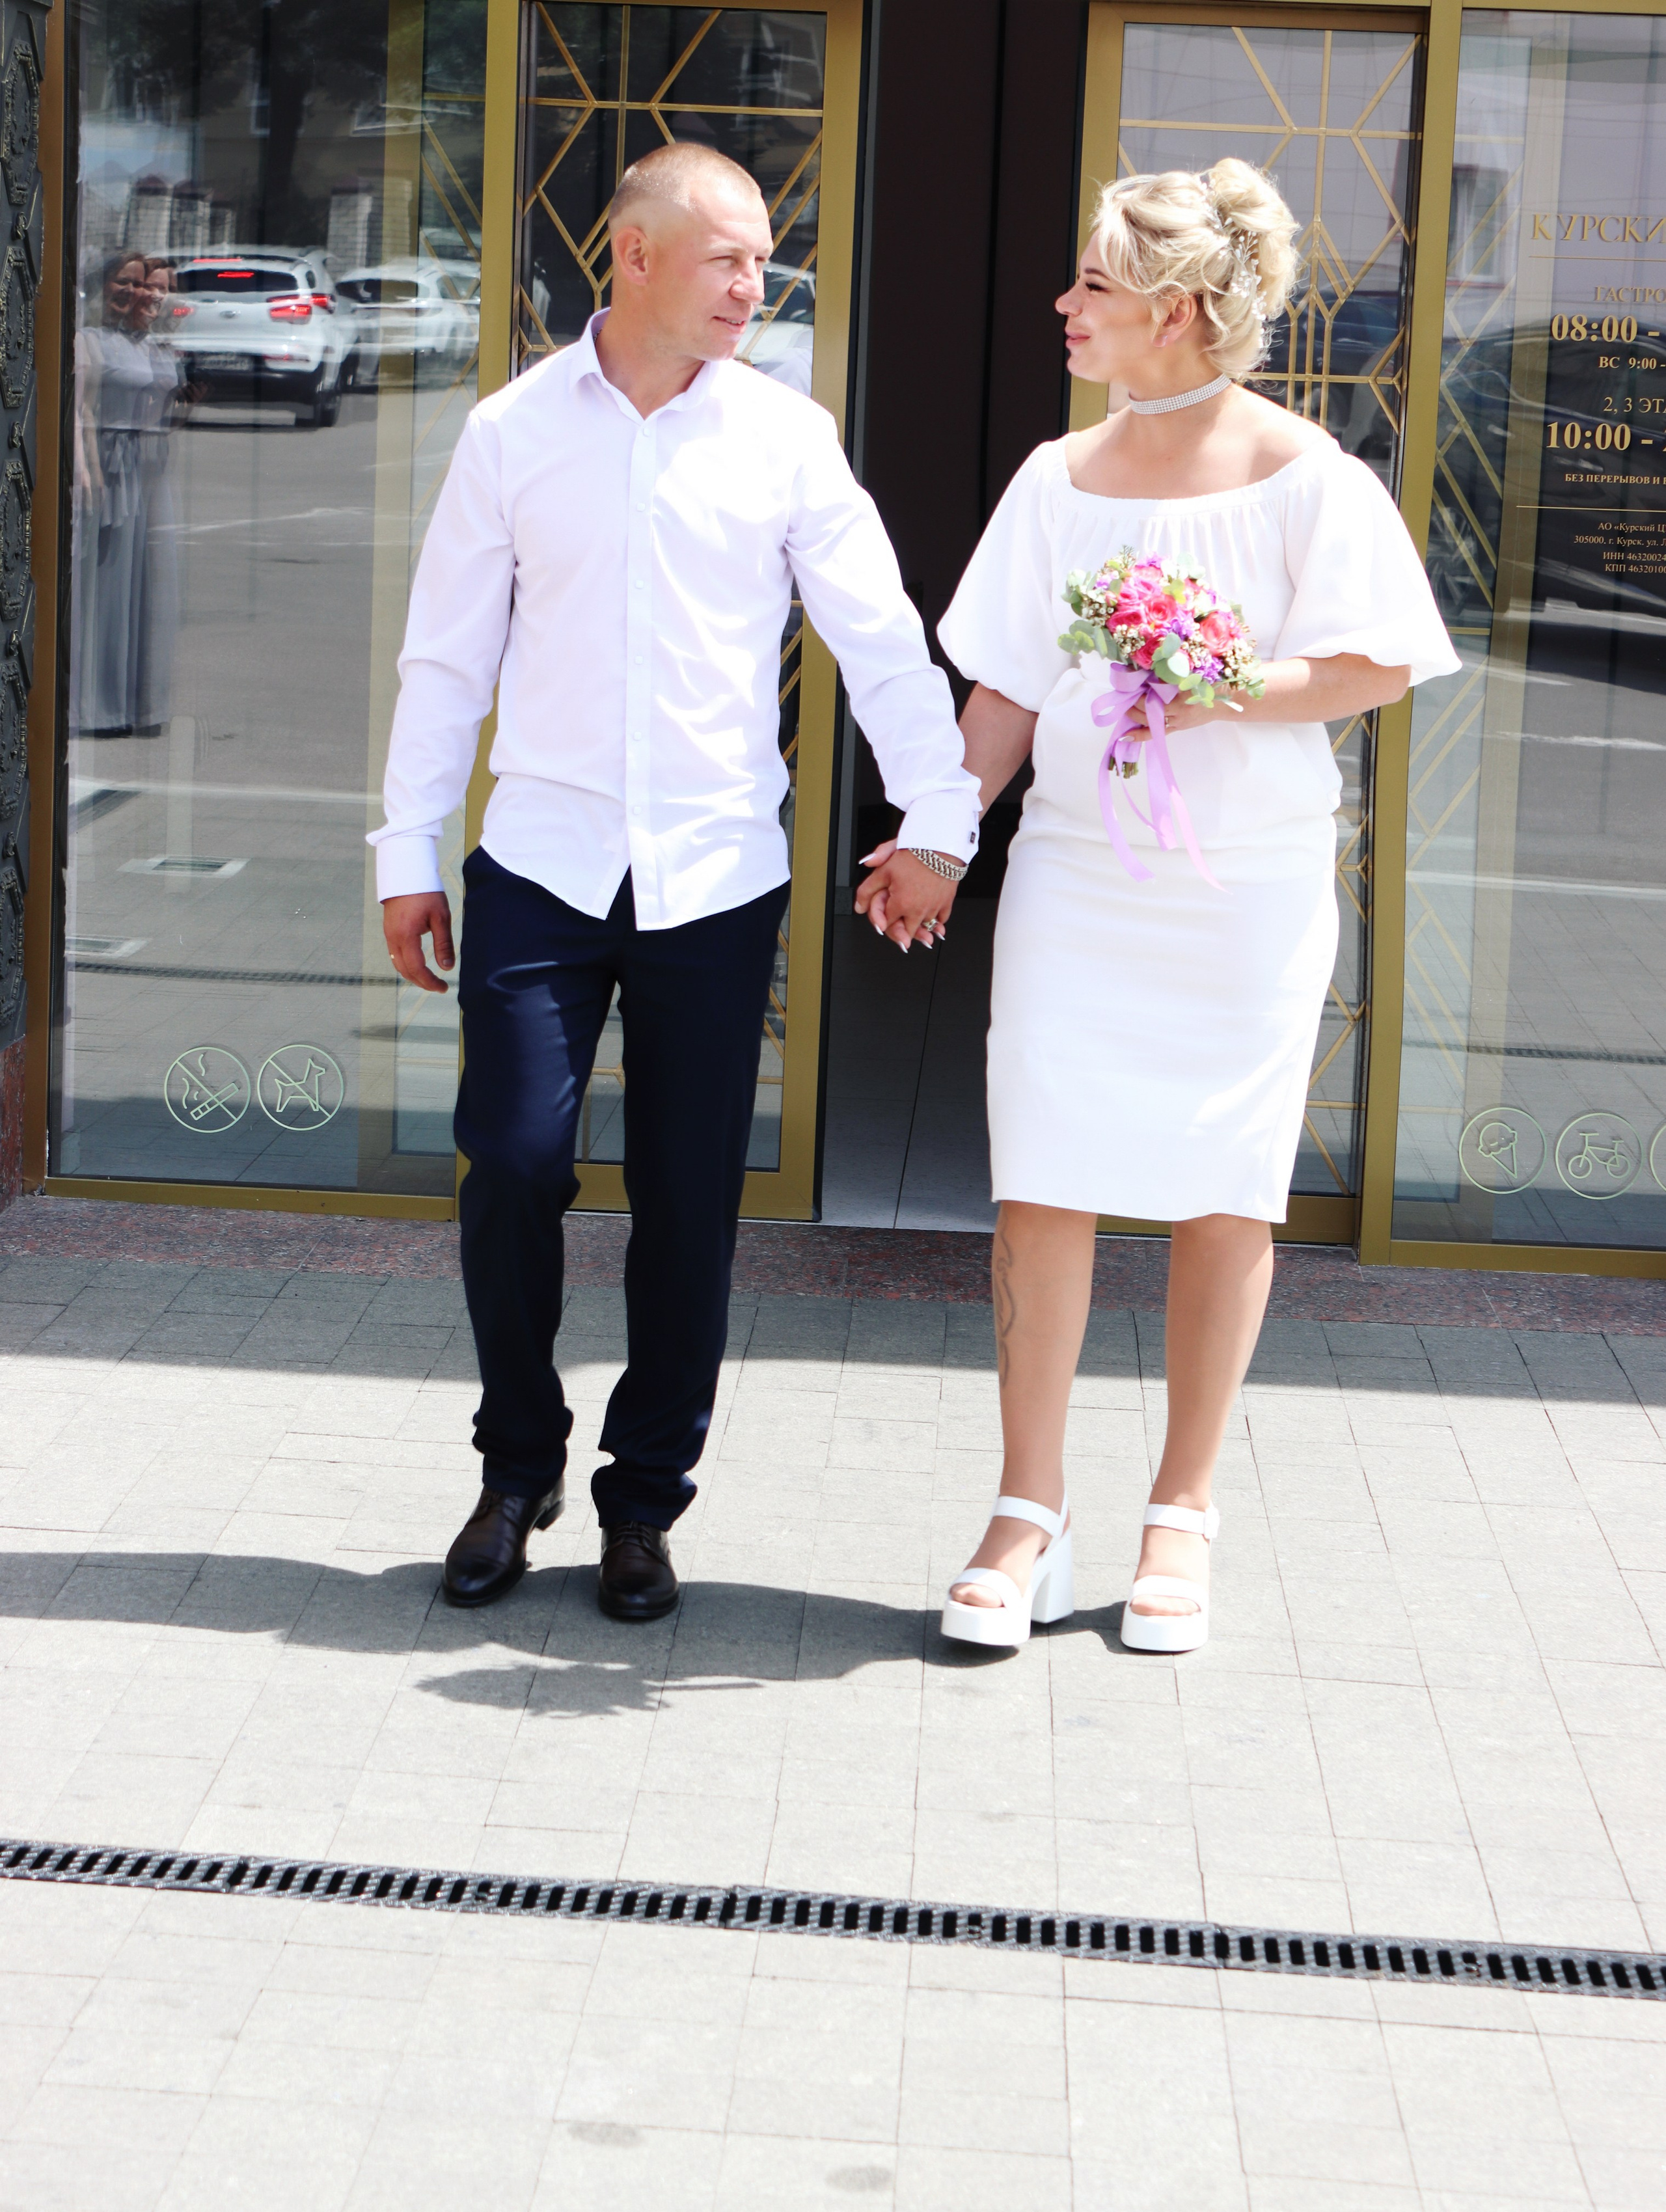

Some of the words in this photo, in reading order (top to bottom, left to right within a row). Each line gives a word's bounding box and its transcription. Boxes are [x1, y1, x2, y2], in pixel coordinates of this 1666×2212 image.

[1531, 213, 1666, 243] КУРСКИ
[1594, 286, 1666, 303] ГАСТРО
[1551, 314, 1637, 343] 08:00
[1598, 356, 1620, 368] ВС
[1628, 357, 1657, 370] 9:00
[1603, 396, 1618, 415] 2,
[1623, 397, 1632, 413] 3
[1639, 398, 1666, 413] ЭТ
[1546, 422, 1631, 450] 10:00
[1565, 474, 1583, 482] БЕЗ
[1586, 474, 1650, 484] ПЕРЕРЫВОВ
[1652, 476, 1660, 485] И
[1614, 523, 1655, 532] «Курский
[1603, 552, 1624, 560] ИНН
